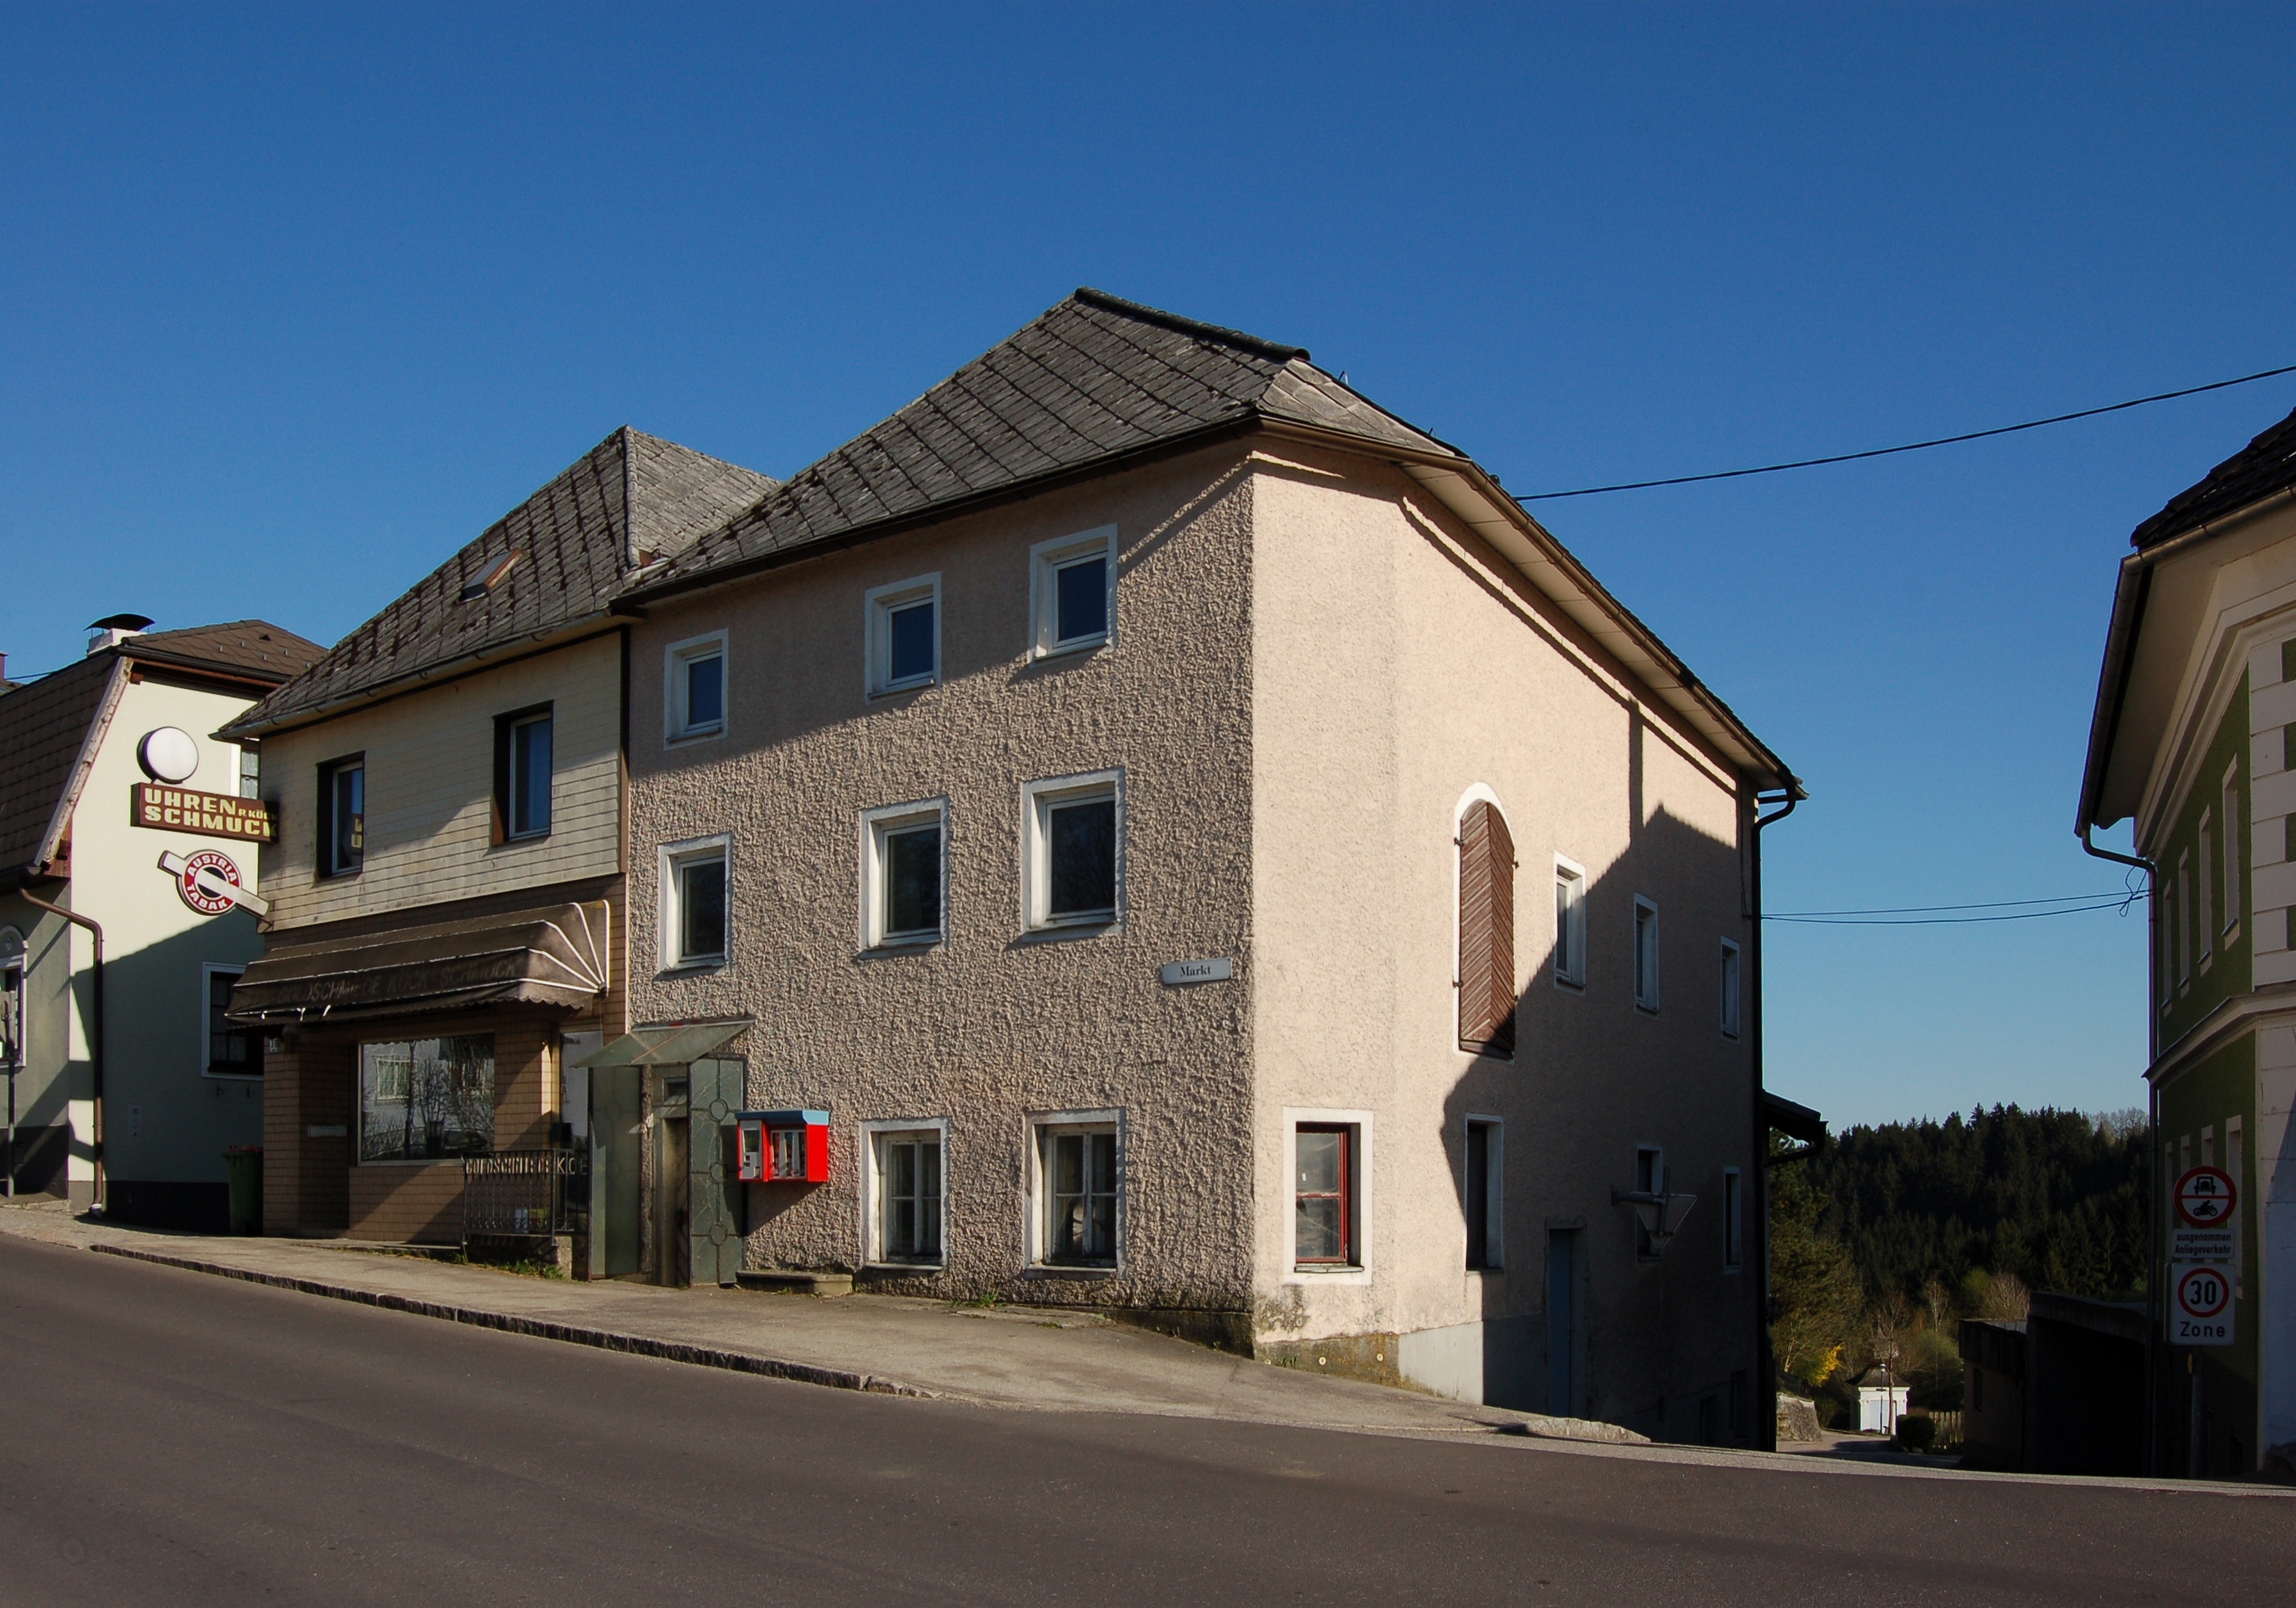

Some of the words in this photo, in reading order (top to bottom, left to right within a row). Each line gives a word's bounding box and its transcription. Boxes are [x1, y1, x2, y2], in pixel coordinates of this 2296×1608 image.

[144, 788, 236, 815] UHREN
[144, 806, 278, 837] SCHMUCK
[187, 854, 238, 882] AUSTRIA
[187, 883, 227, 910] TABAK
[1180, 965, 1211, 977] Markt
[2175, 1244, 2231, 1255] Anliegeverkehr
[2176, 1232, 2231, 1244] ausgenommen
[2189, 1280, 2217, 1305] 30
[2179, 1321, 2226, 1338] Zone
